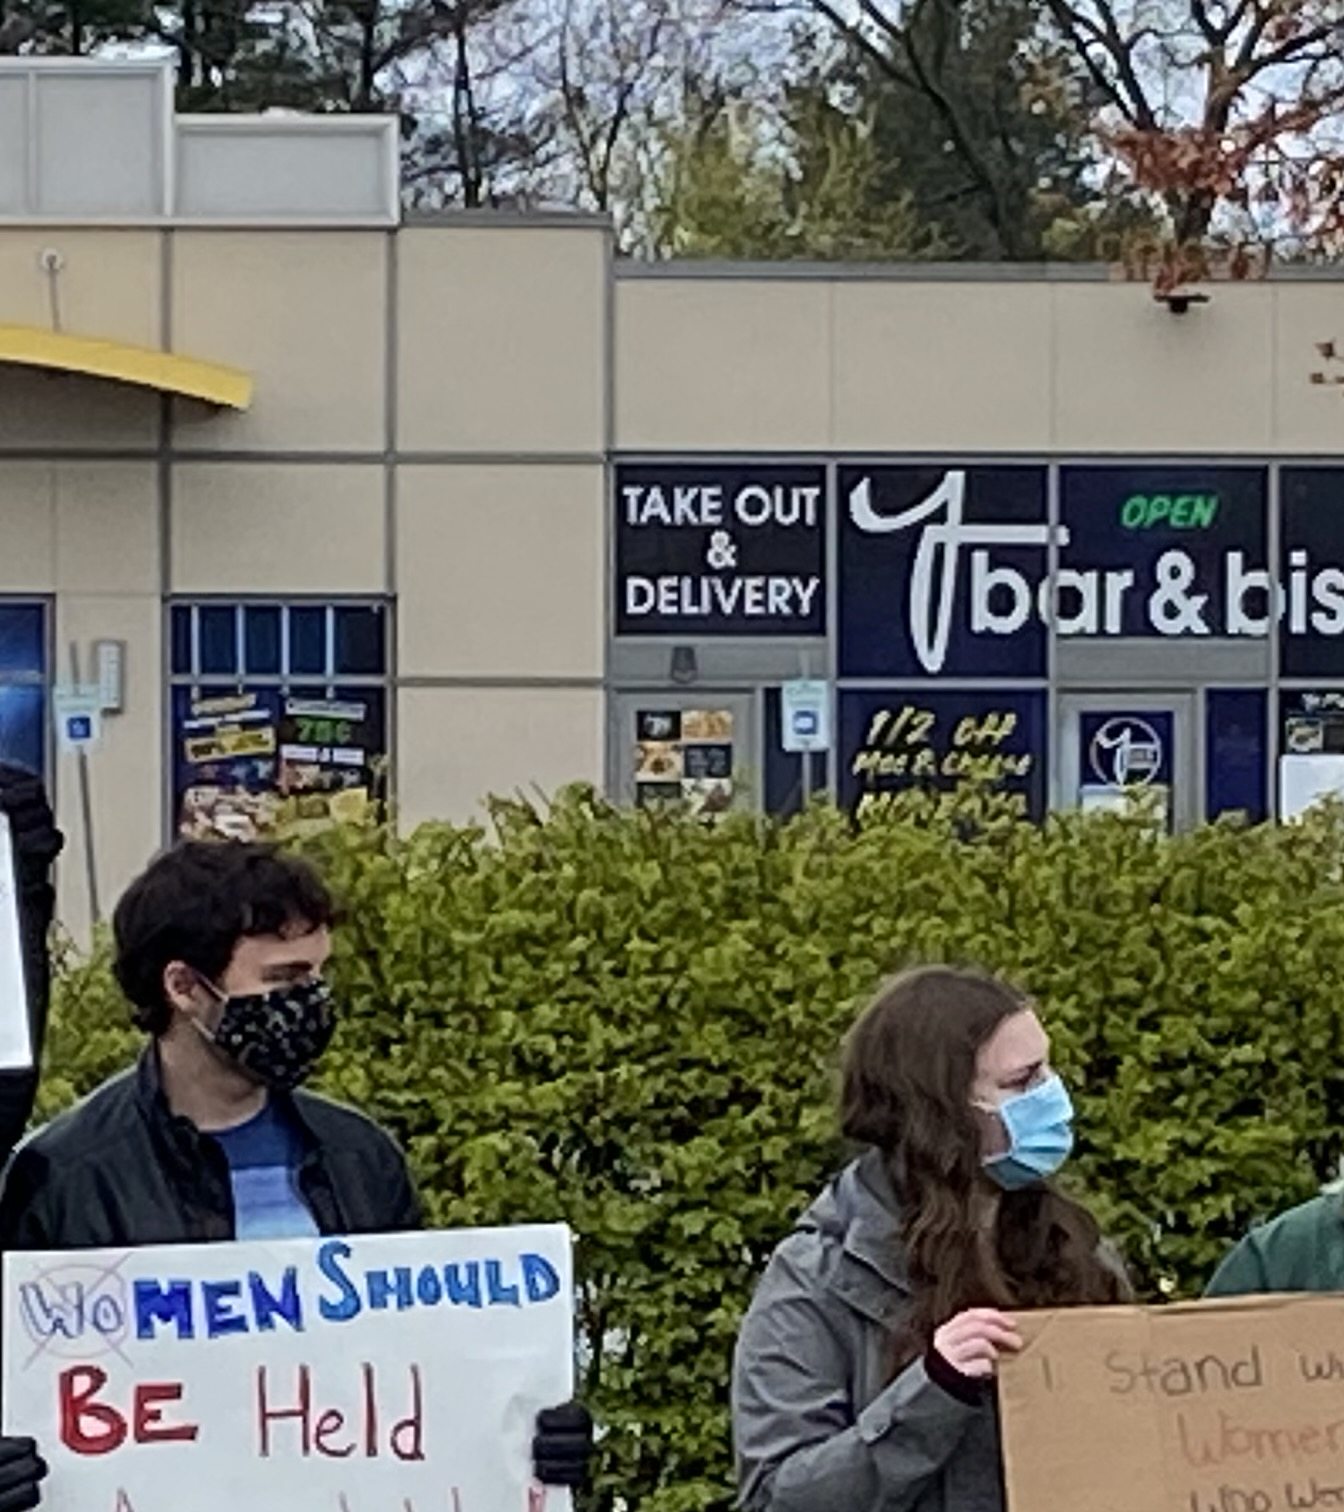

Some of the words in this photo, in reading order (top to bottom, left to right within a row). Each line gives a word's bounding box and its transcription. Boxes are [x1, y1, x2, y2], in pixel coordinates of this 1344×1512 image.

[622, 486, 723, 526] TAKE
[734, 486, 821, 526] OUT
[1120, 495, 1219, 528] OPEN
[705, 530, 738, 570] &
[625, 576, 821, 616] DELIVERY
[970, 549, 1134, 635] bar
[1149, 549, 1211, 635] &
[866, 706, 936, 746] 1/2
[58, 1365, 199, 1456] BE
[258, 1362, 426, 1460] Held
